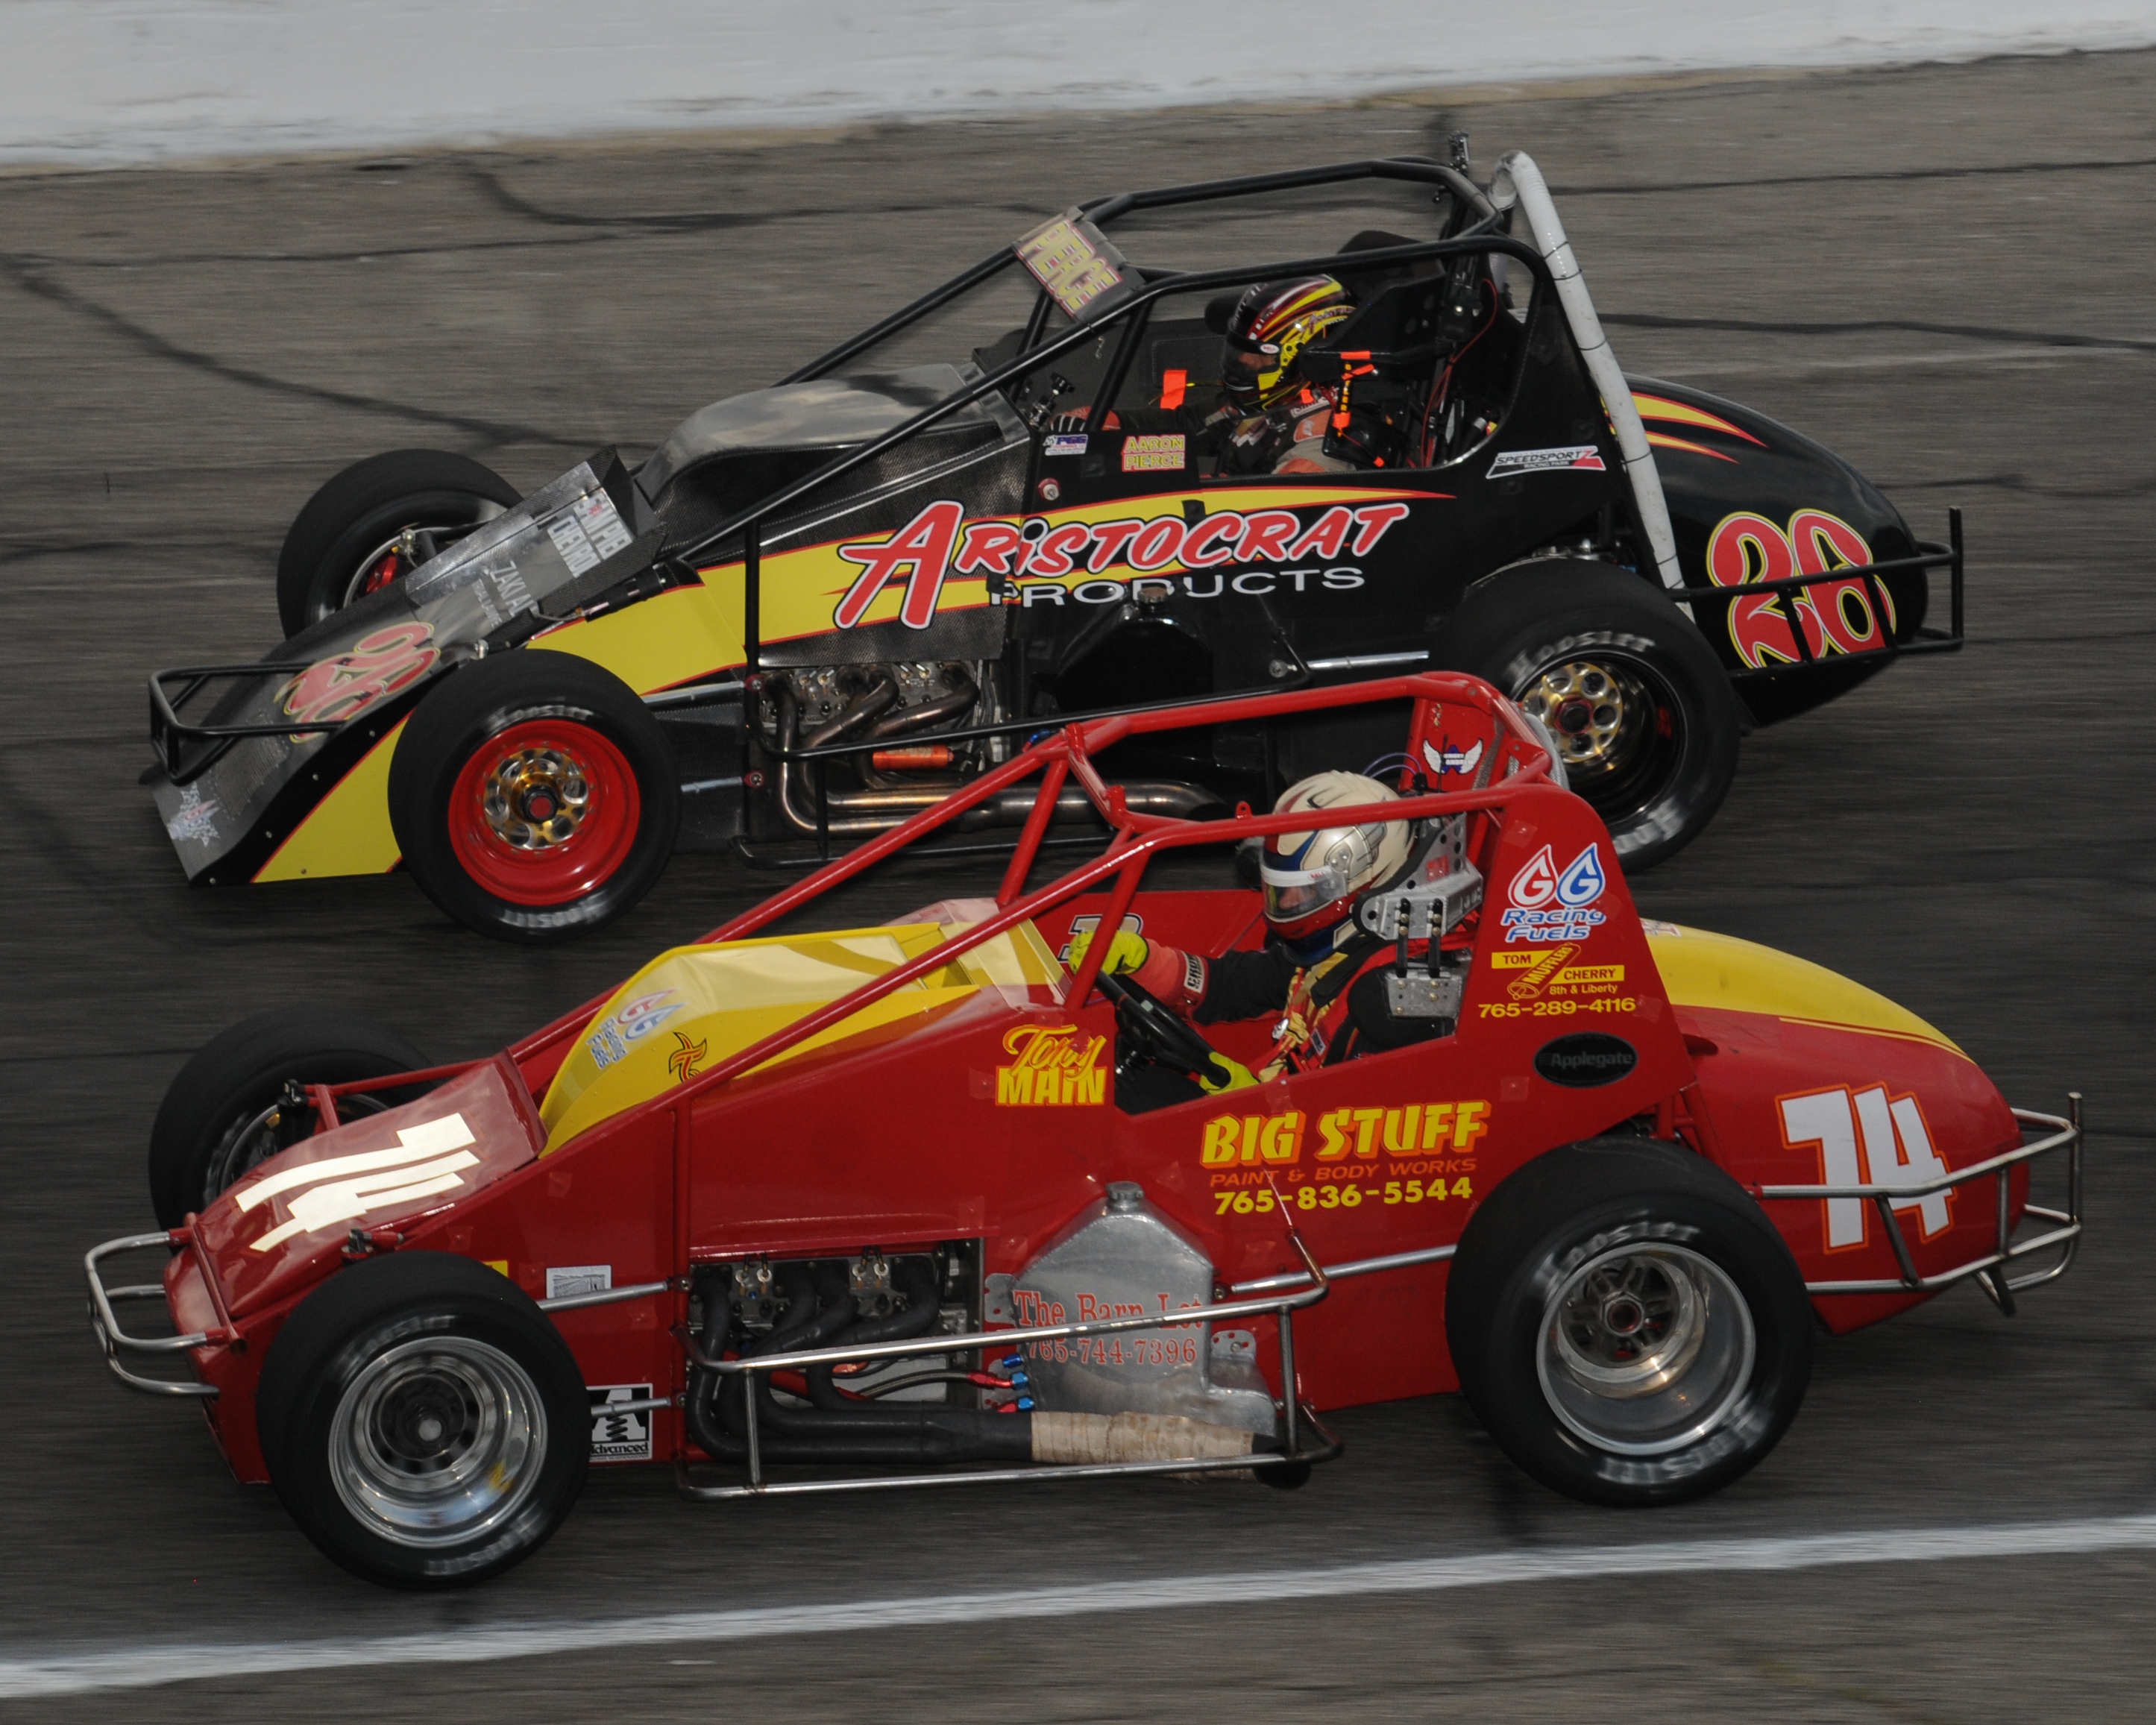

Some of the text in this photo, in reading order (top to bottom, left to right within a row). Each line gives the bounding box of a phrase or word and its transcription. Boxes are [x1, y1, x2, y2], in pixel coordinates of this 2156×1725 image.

[1016, 219, 1123, 317] PIERCE
[1125, 436, 1184, 452] AARON
[1125, 452, 1184, 470] PIERCE
[1706, 509, 1896, 669] 26
[1500, 908, 1606, 926] Racing
[1505, 925, 1591, 943] Fuels
[1502, 954, 1531, 965] TOM
[1563, 968, 1616, 981] CHERRY
[1549, 984, 1618, 995] 8th & Liberty
[1478, 997, 1636, 1018] 765-289-4116
[1550, 1052, 1633, 1069] Applegate
[995, 1065, 1106, 1106] MAIN
[1200, 1099, 1491, 1168] BIG STUFF
[1210, 1159, 1477, 1187] PAINT & BODY WORKS
[1775, 1081, 1957, 1254] 74
[1215, 1177, 1473, 1215] 765-836-5544
[1013, 1289, 1065, 1327] The
[1028, 1337, 1197, 1364] 765-744-7396
